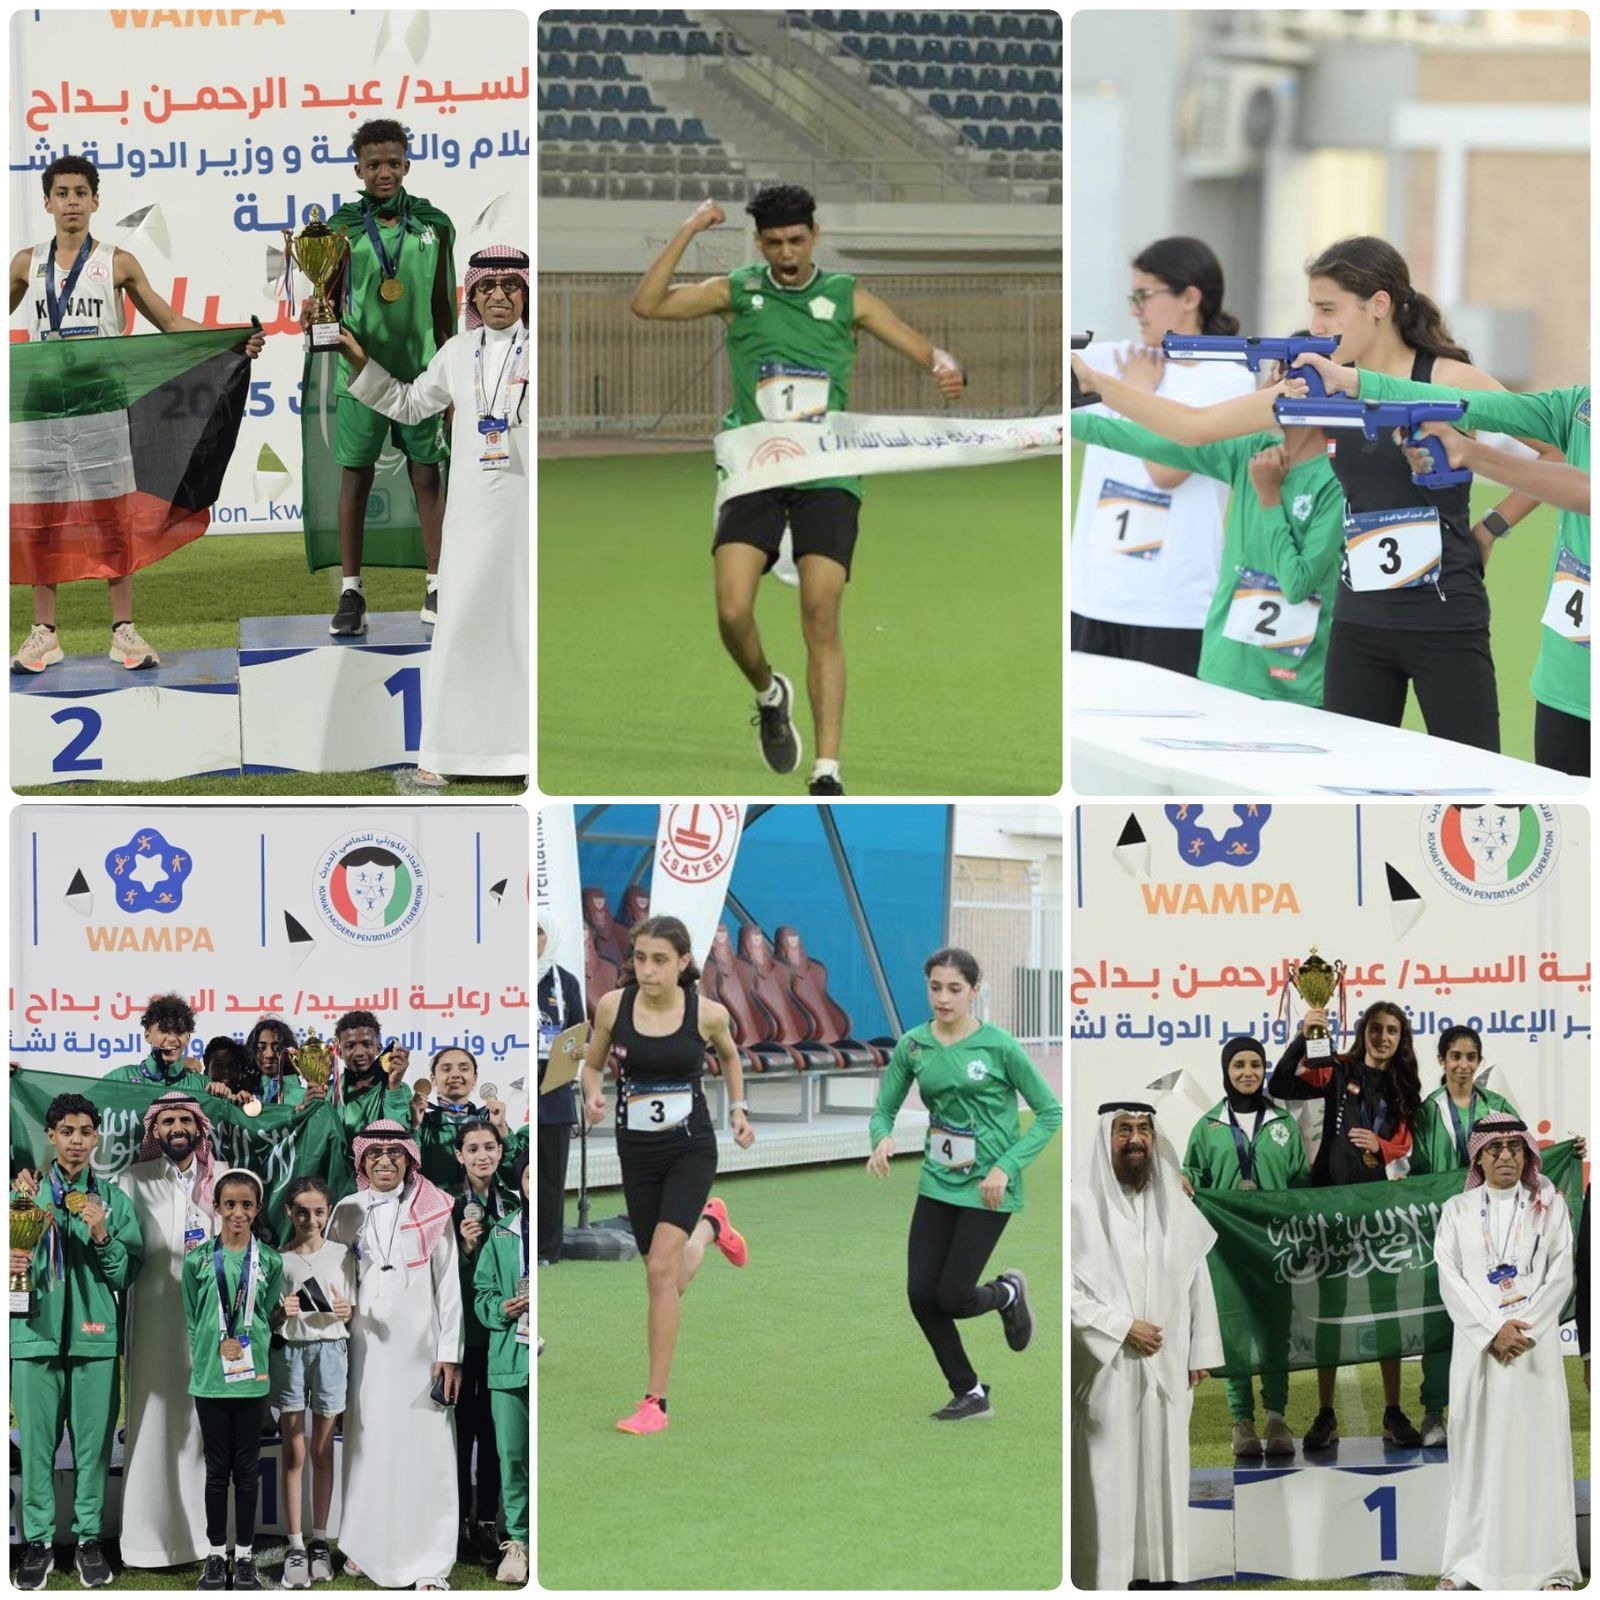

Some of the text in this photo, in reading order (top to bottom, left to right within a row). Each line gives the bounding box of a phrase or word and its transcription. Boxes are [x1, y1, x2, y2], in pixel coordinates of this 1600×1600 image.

[26, 81, 130, 132] بداح
[144, 76, 287, 124] الرحمن
[302, 80, 383, 119] عبد
[196, 138, 274, 177] وزير
[781, 384, 794, 411] 1
[1116, 509, 1130, 540] 1
[1378, 537, 1402, 575] 3
[1254, 600, 1281, 637] 2
[1565, 588, 1585, 628] 4
[384, 668, 422, 752] 1
[50, 706, 103, 773] 2
[1427, 830, 1554, 900] KUWAIT MODERN PENTATHLON FEDERATION
[319, 884, 424, 942] KUWAIT MODERN PENTATHLON FEDERATION
[1141, 882, 1301, 915] WAMPA
[86, 926, 215, 953] WAMPA
[25, 988, 101, 1025] بداح
[408, 984, 490, 1018] رعاية
[63, 1031, 141, 1059] الدولة
[1115, 1013, 1211, 1046] الدولة
[650, 1100, 666, 1123] 3
[942, 1138, 953, 1160] 4
[1363, 1486, 1397, 1561] 1
